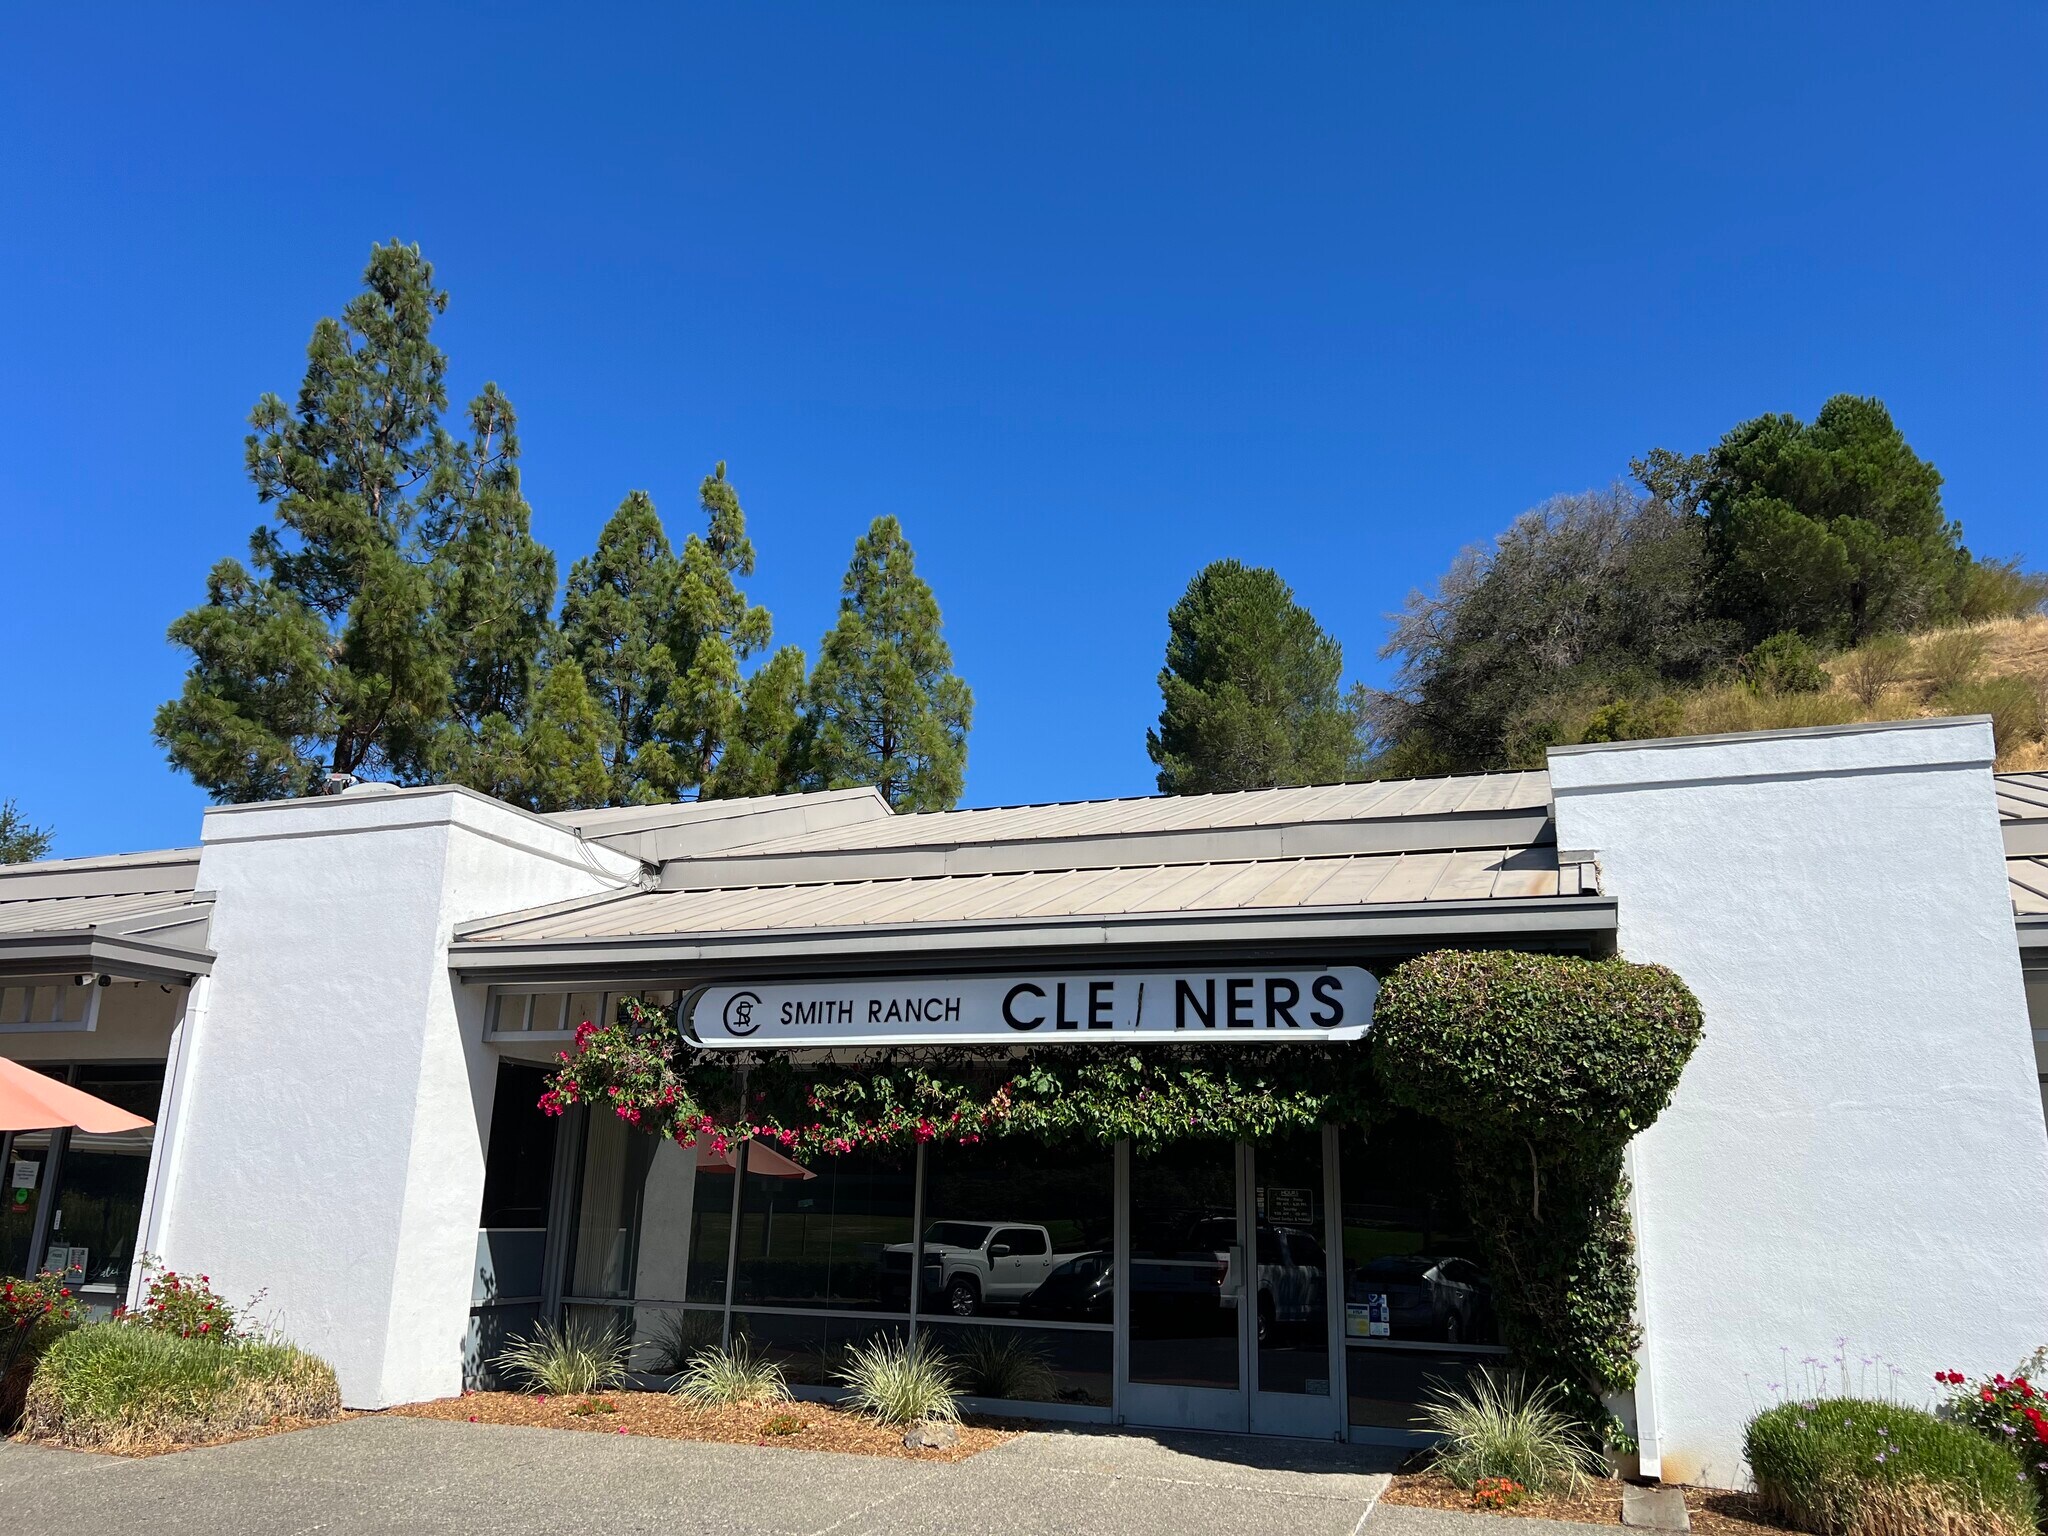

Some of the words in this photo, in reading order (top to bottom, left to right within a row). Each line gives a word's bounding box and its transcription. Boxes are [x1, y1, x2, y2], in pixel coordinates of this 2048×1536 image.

[780, 1000, 853, 1025] SMITH
[868, 997, 962, 1023] RANCH
[1002, 975, 1344, 1032] CLENERS
